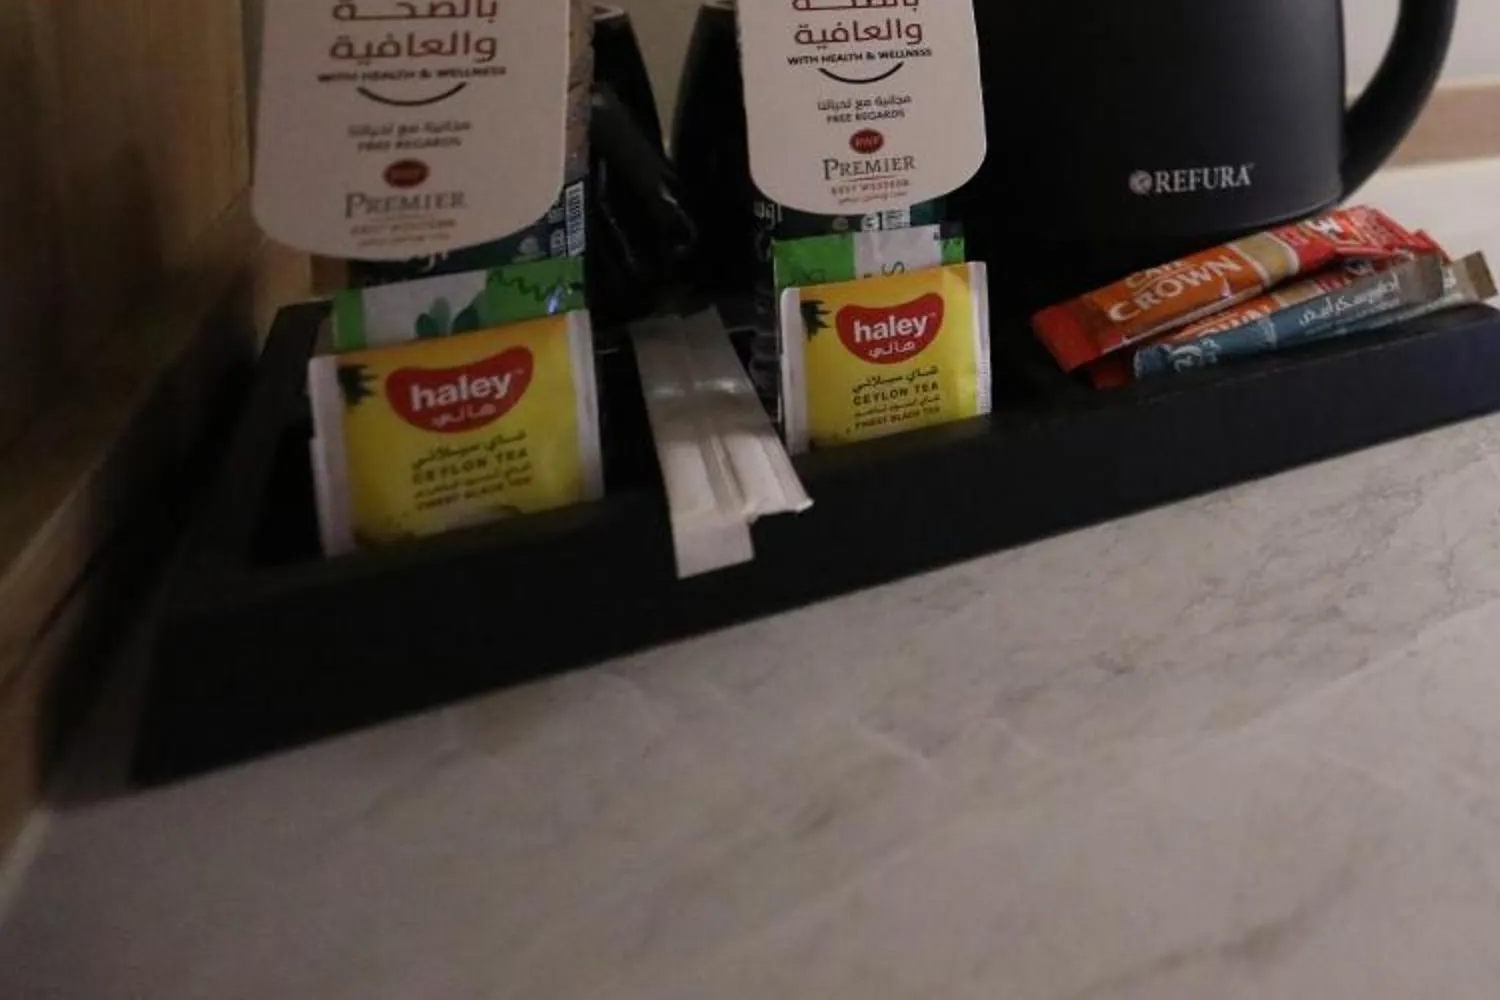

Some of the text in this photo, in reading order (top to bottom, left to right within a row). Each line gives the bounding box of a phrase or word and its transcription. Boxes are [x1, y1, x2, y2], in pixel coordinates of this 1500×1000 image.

[795, 17, 922, 49] والعافية
[330, 31, 498, 65] والعافية
[787, 55, 818, 65] WITH
[821, 52, 862, 63] HEALTH
[865, 51, 877, 60] &
[822, 156, 916, 180] PREMIER
[1154, 164, 1253, 194] REFURA
[345, 191, 467, 219] PREMIER
[1107, 254, 1244, 322] CROWN
[853, 314, 928, 343] haley
[411, 372, 512, 412] haley
[853, 381, 940, 406] CEYLON TEA
